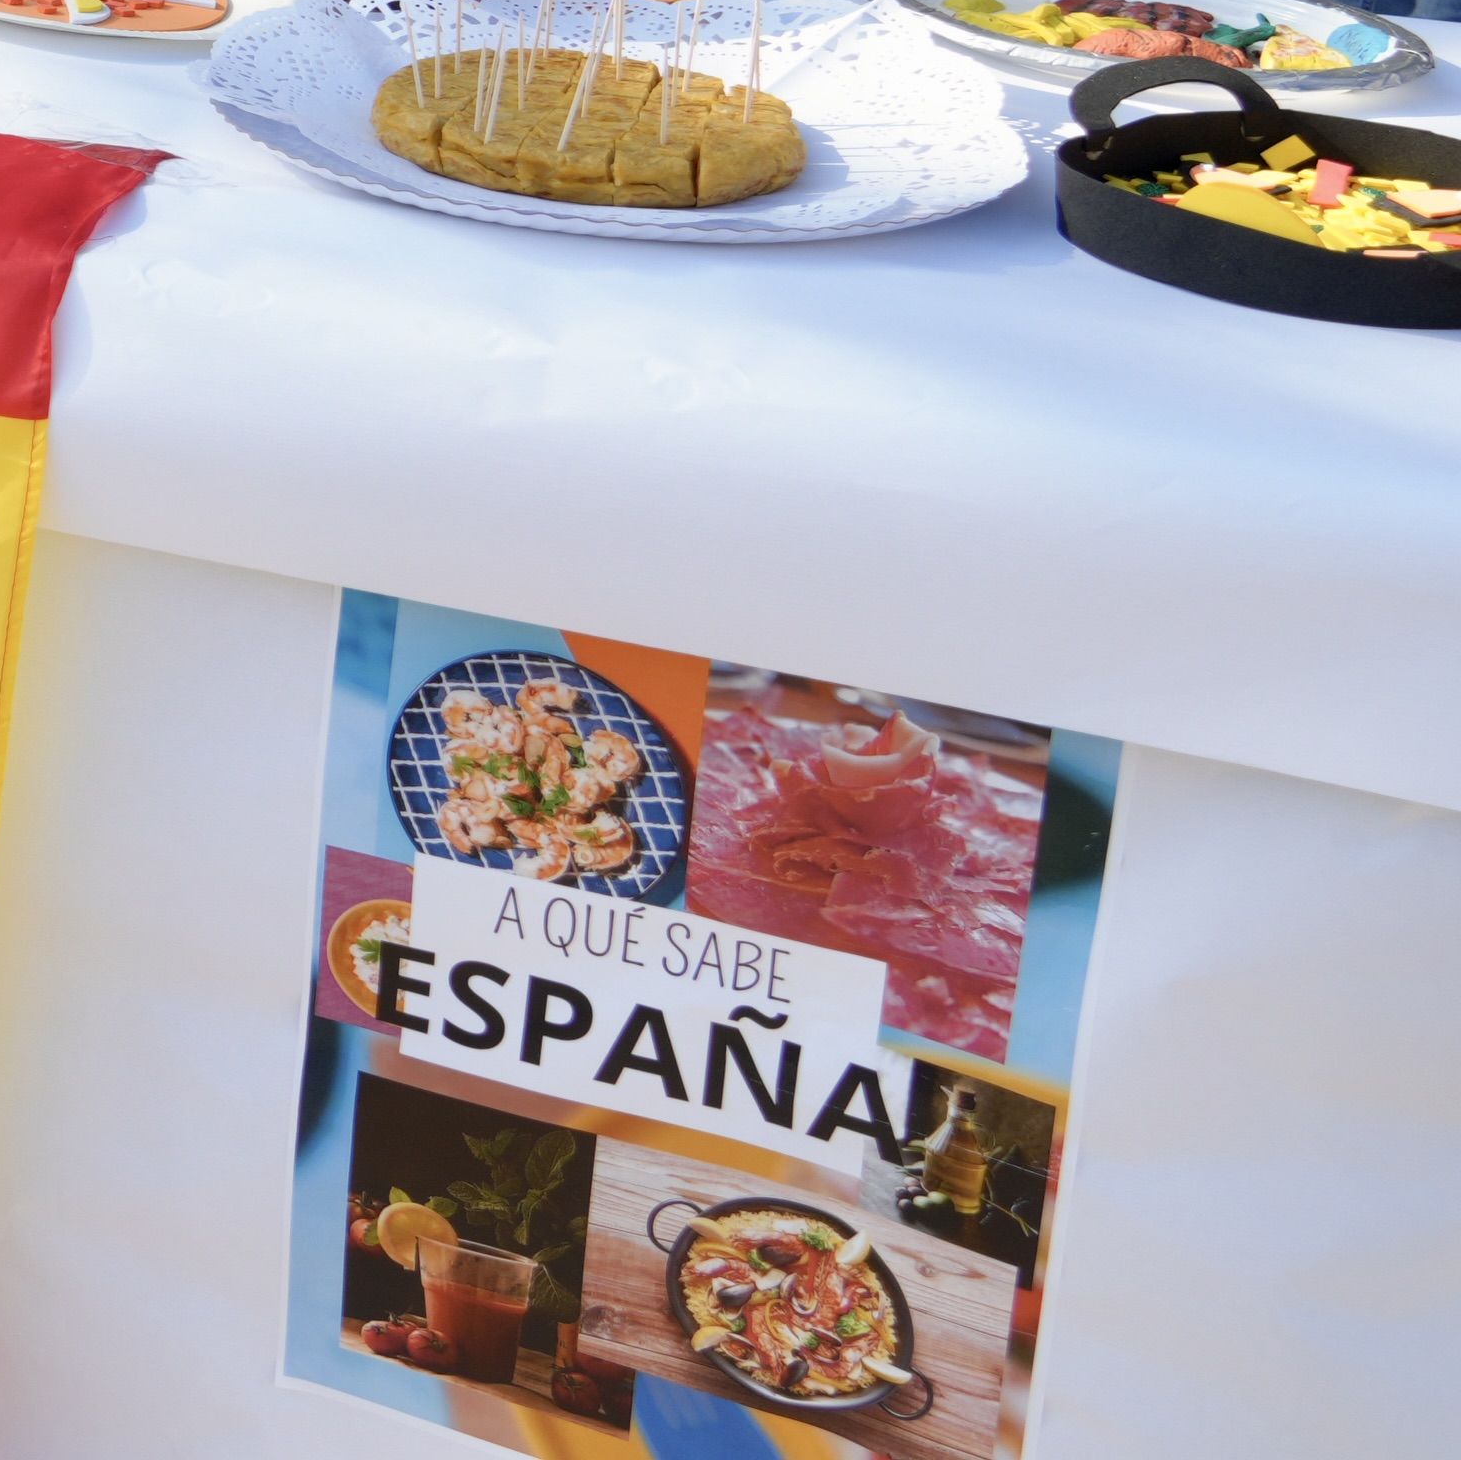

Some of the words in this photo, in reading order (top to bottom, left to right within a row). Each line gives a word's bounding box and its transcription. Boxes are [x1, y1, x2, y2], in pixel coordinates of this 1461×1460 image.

[493, 886, 525, 940] A
[543, 897, 647, 968] QUÉ
[661, 922, 793, 1004] SABE
[375, 940, 905, 1166] ESPAÑA
